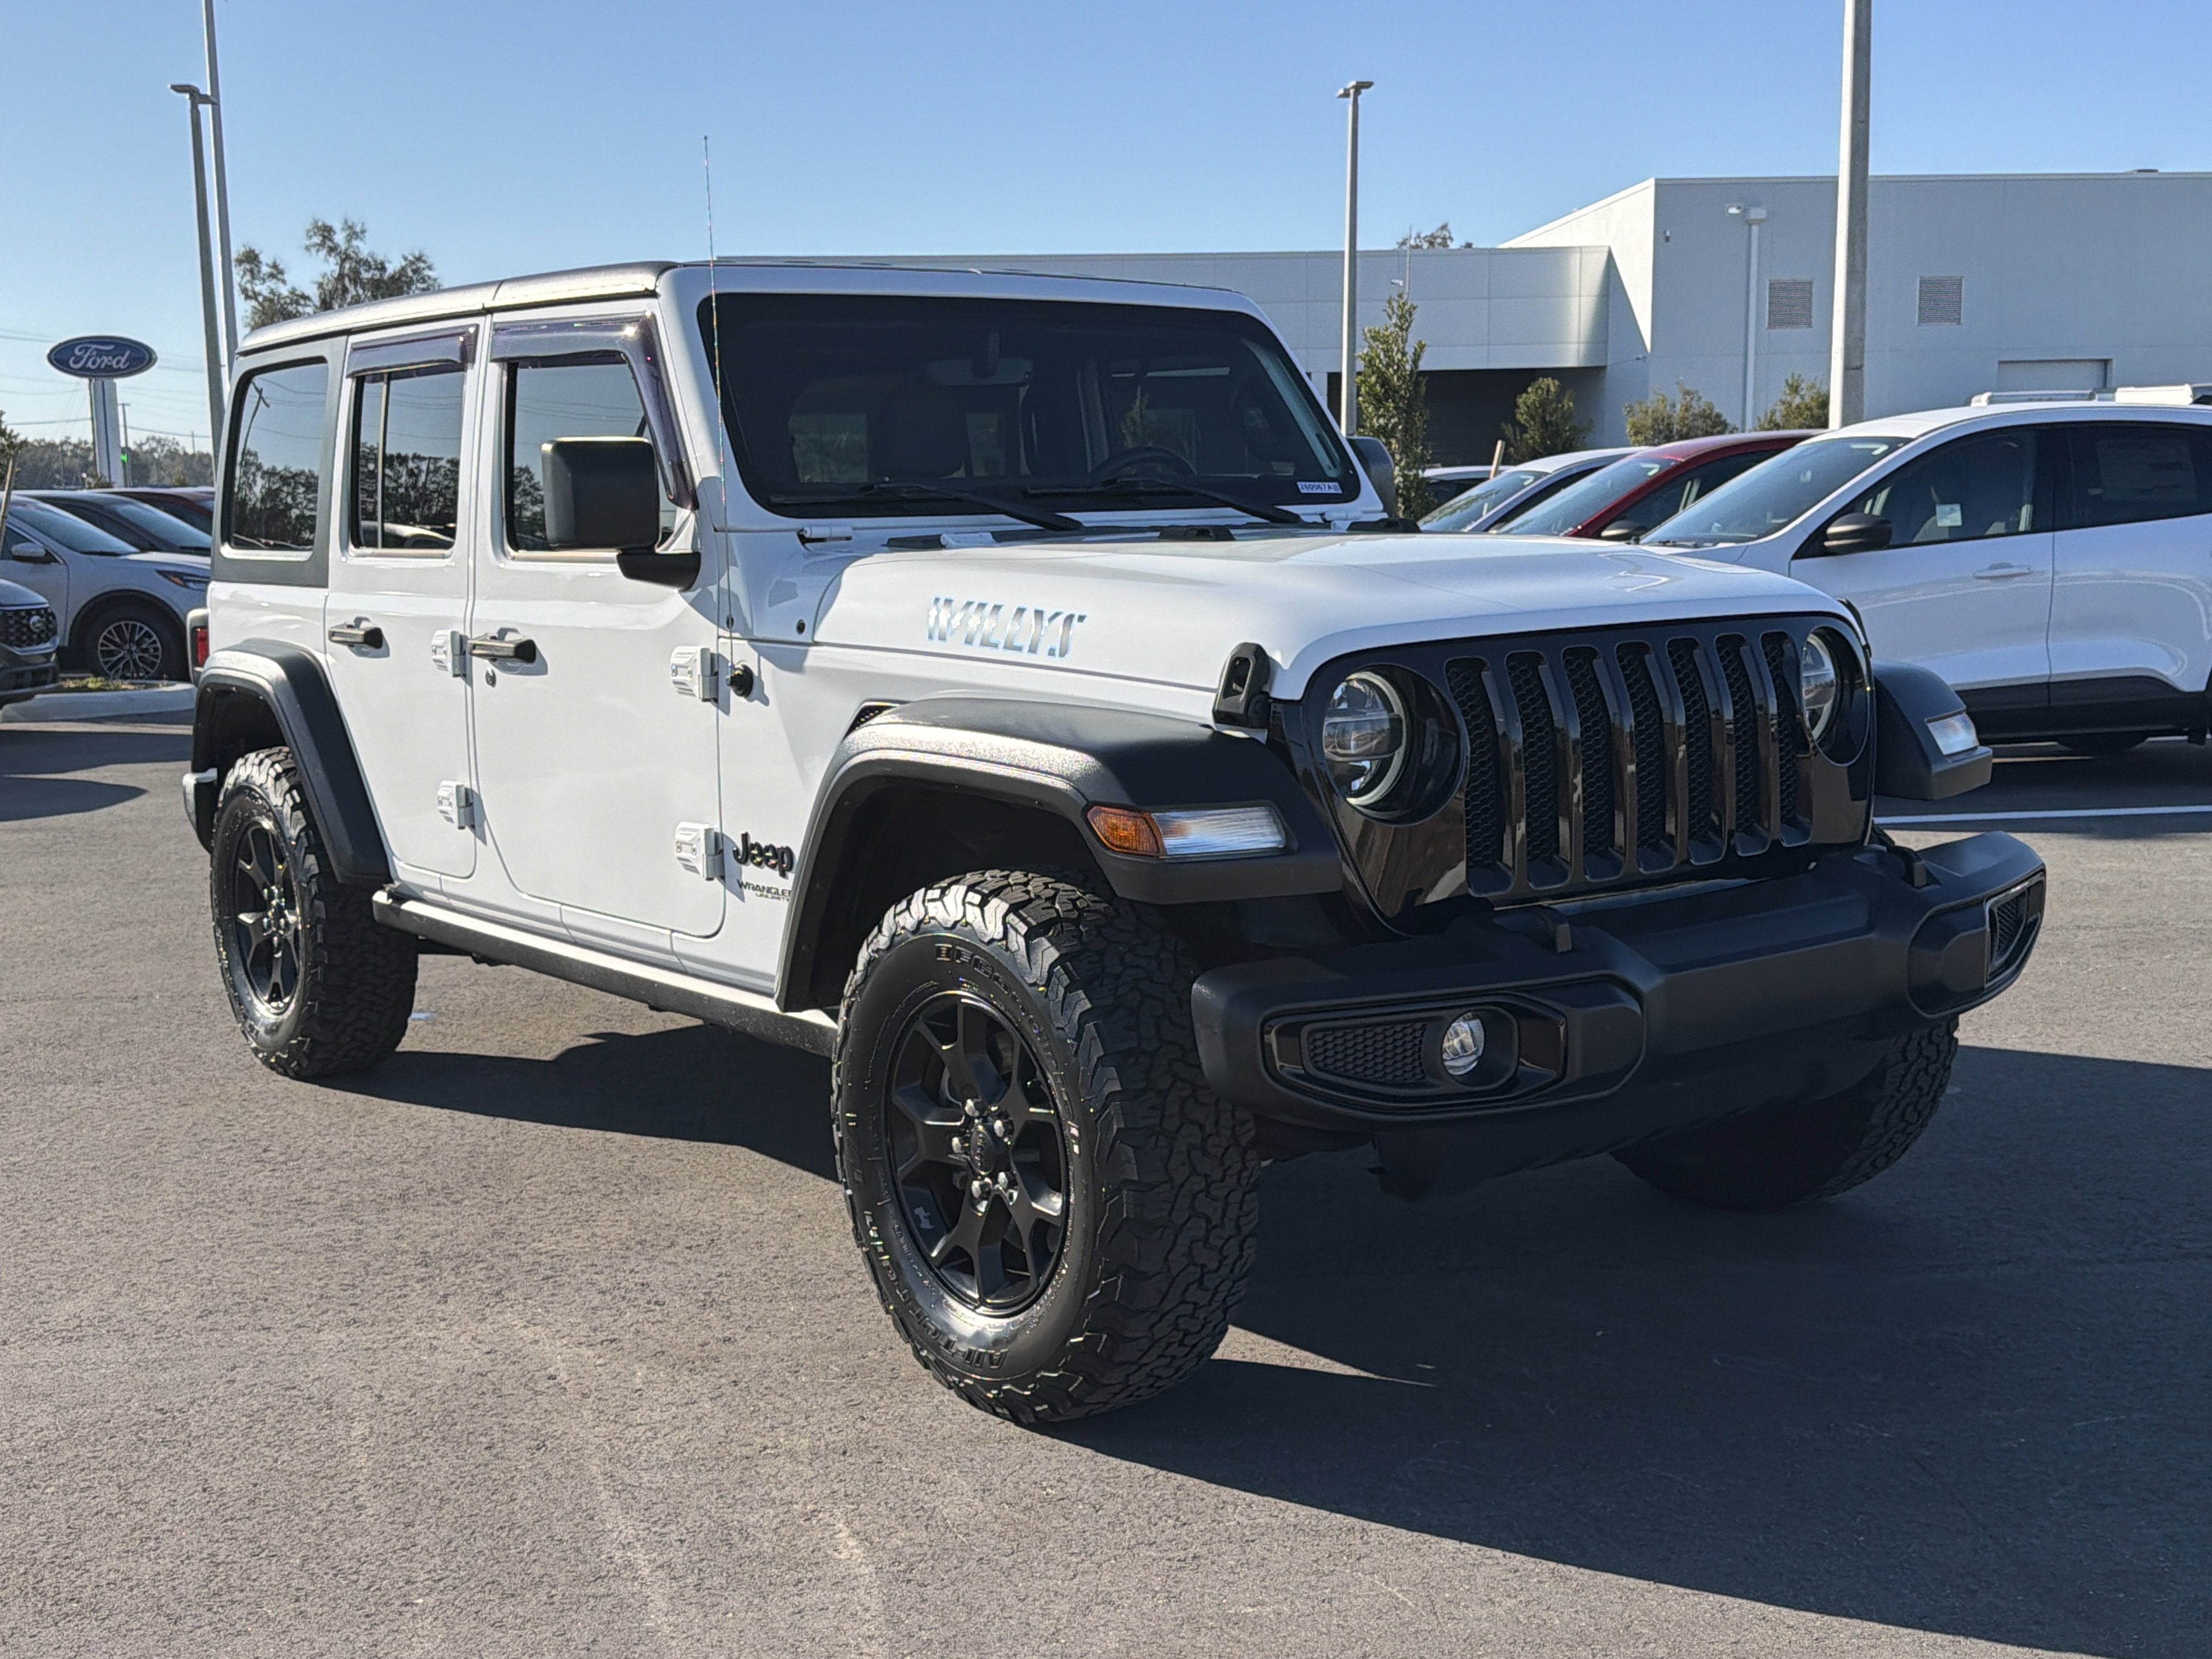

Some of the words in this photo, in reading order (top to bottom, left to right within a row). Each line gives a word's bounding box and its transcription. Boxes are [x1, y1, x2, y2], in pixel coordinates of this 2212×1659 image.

[69, 344, 130, 369] Ford
[927, 596, 1087, 658] WILLYS
[732, 831, 794, 878] Jeep
